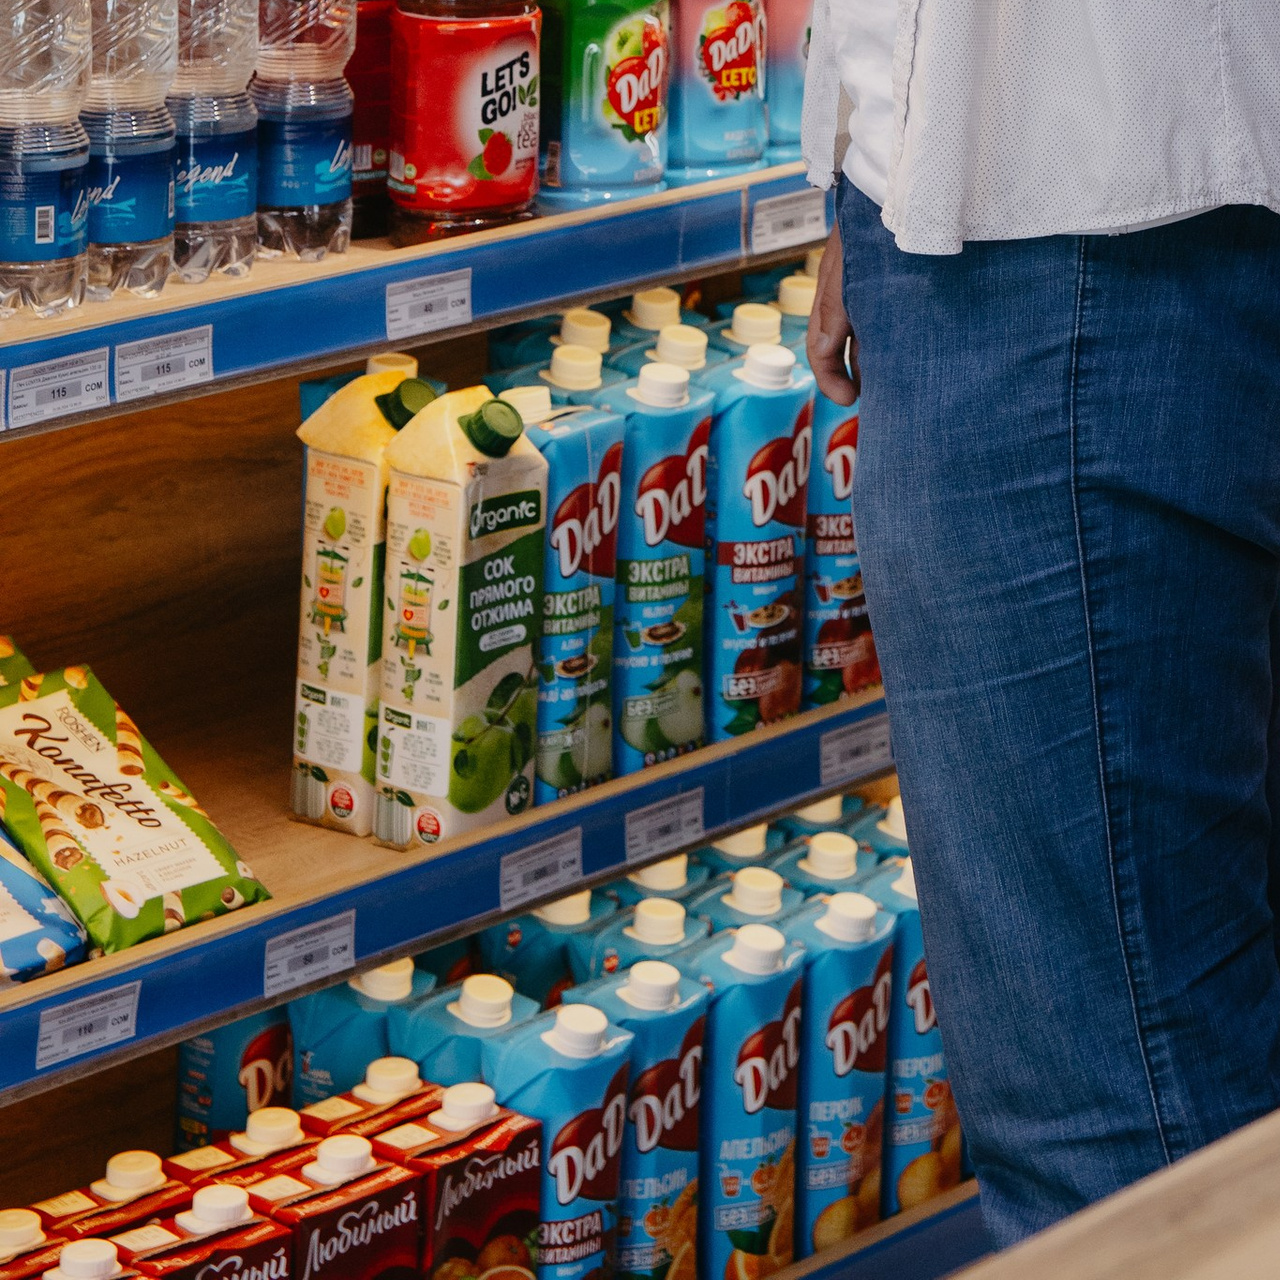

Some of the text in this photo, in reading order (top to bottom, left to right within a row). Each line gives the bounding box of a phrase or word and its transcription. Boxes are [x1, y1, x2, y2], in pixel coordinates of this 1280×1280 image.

[481, 50, 530, 97] LET'S
[481, 86, 517, 125] GO!
[156, 357, 206, 375] 115 СОМ
[50, 381, 103, 399] 115 СОМ
[470, 500, 537, 539] Organic
[484, 555, 516, 581] СОК
[628, 553, 690, 583] ЭКСТРА
[733, 538, 795, 566] ЭКСТРА
[469, 575, 535, 609] ПРЯМОГО
[542, 583, 601, 616] ЭКСТРА
[470, 597, 535, 631] ОТЖИМА
[56, 705, 106, 753] ROSHEN
[14, 712, 162, 828] Konafetto
[113, 837, 188, 867] HAZELNUT
[435, 1138, 540, 1231] Любимый
[303, 1190, 418, 1280] Любимый
[538, 1212, 602, 1246] ЭКСТРА
